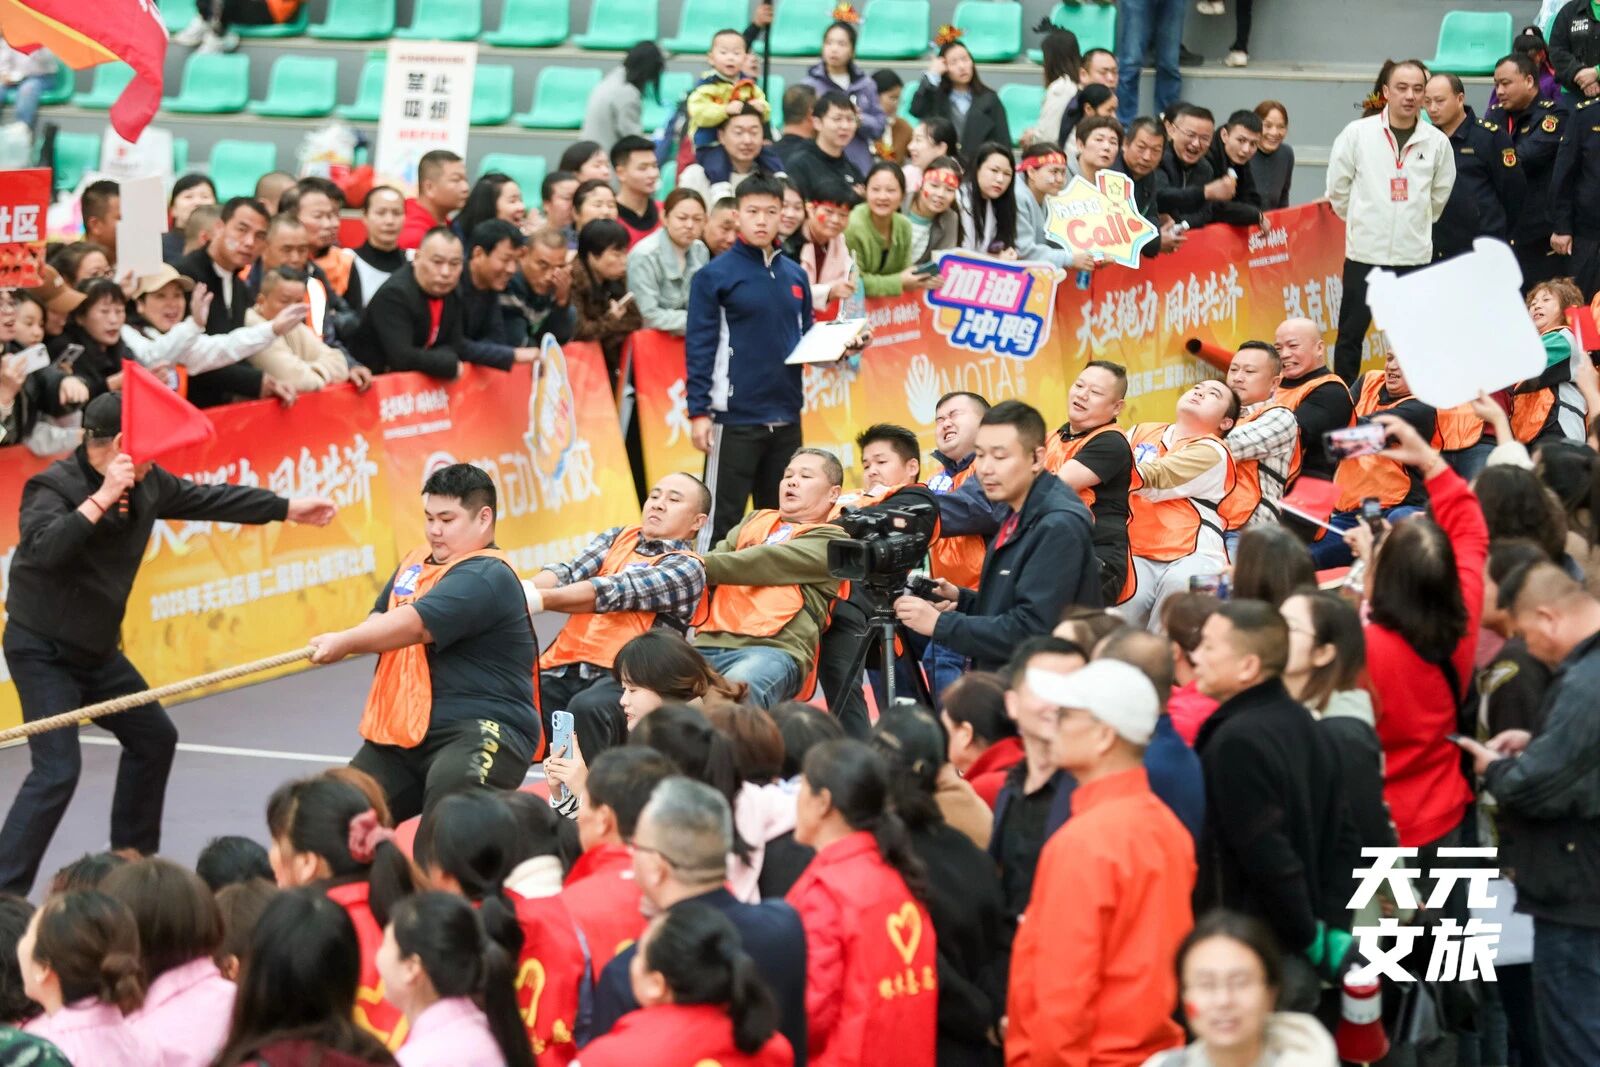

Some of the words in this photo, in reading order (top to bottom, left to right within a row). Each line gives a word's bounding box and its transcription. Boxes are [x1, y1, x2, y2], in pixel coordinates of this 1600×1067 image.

[1066, 212, 1131, 250] Call
[940, 263, 1021, 308] 加油
[1164, 263, 1244, 336] 同舟共济
[956, 308, 1039, 352] 冲鸭
